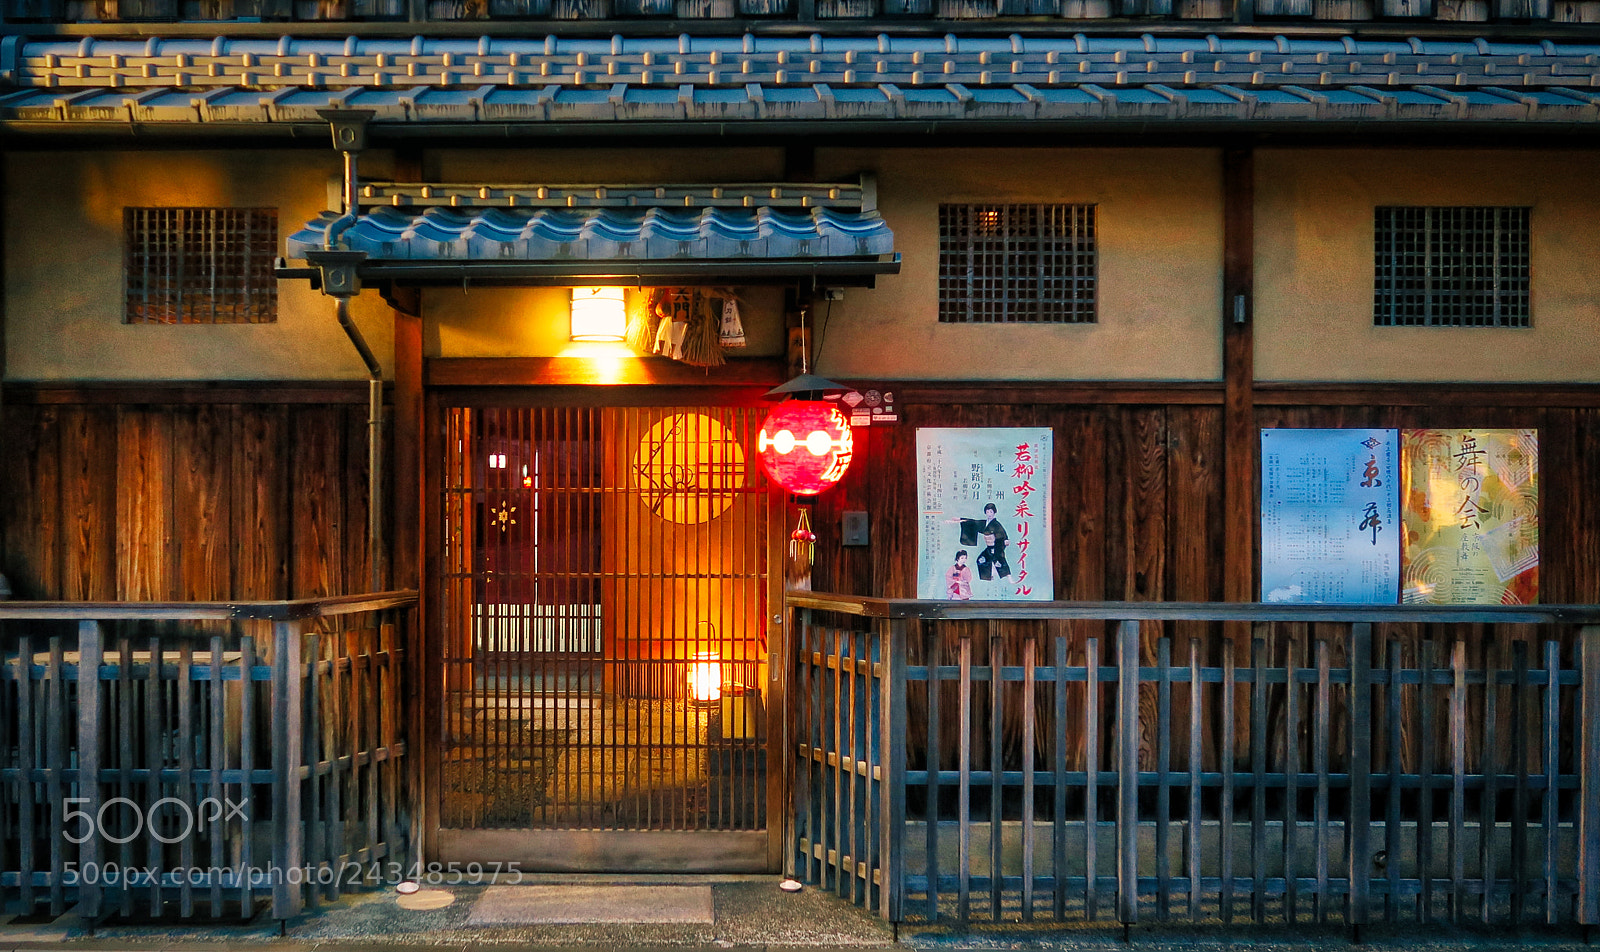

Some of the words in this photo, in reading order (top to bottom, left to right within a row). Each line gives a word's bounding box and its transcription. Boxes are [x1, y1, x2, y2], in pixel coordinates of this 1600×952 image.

[971, 463, 981, 500] 野路の月
[1453, 434, 1490, 530] 舞の会
